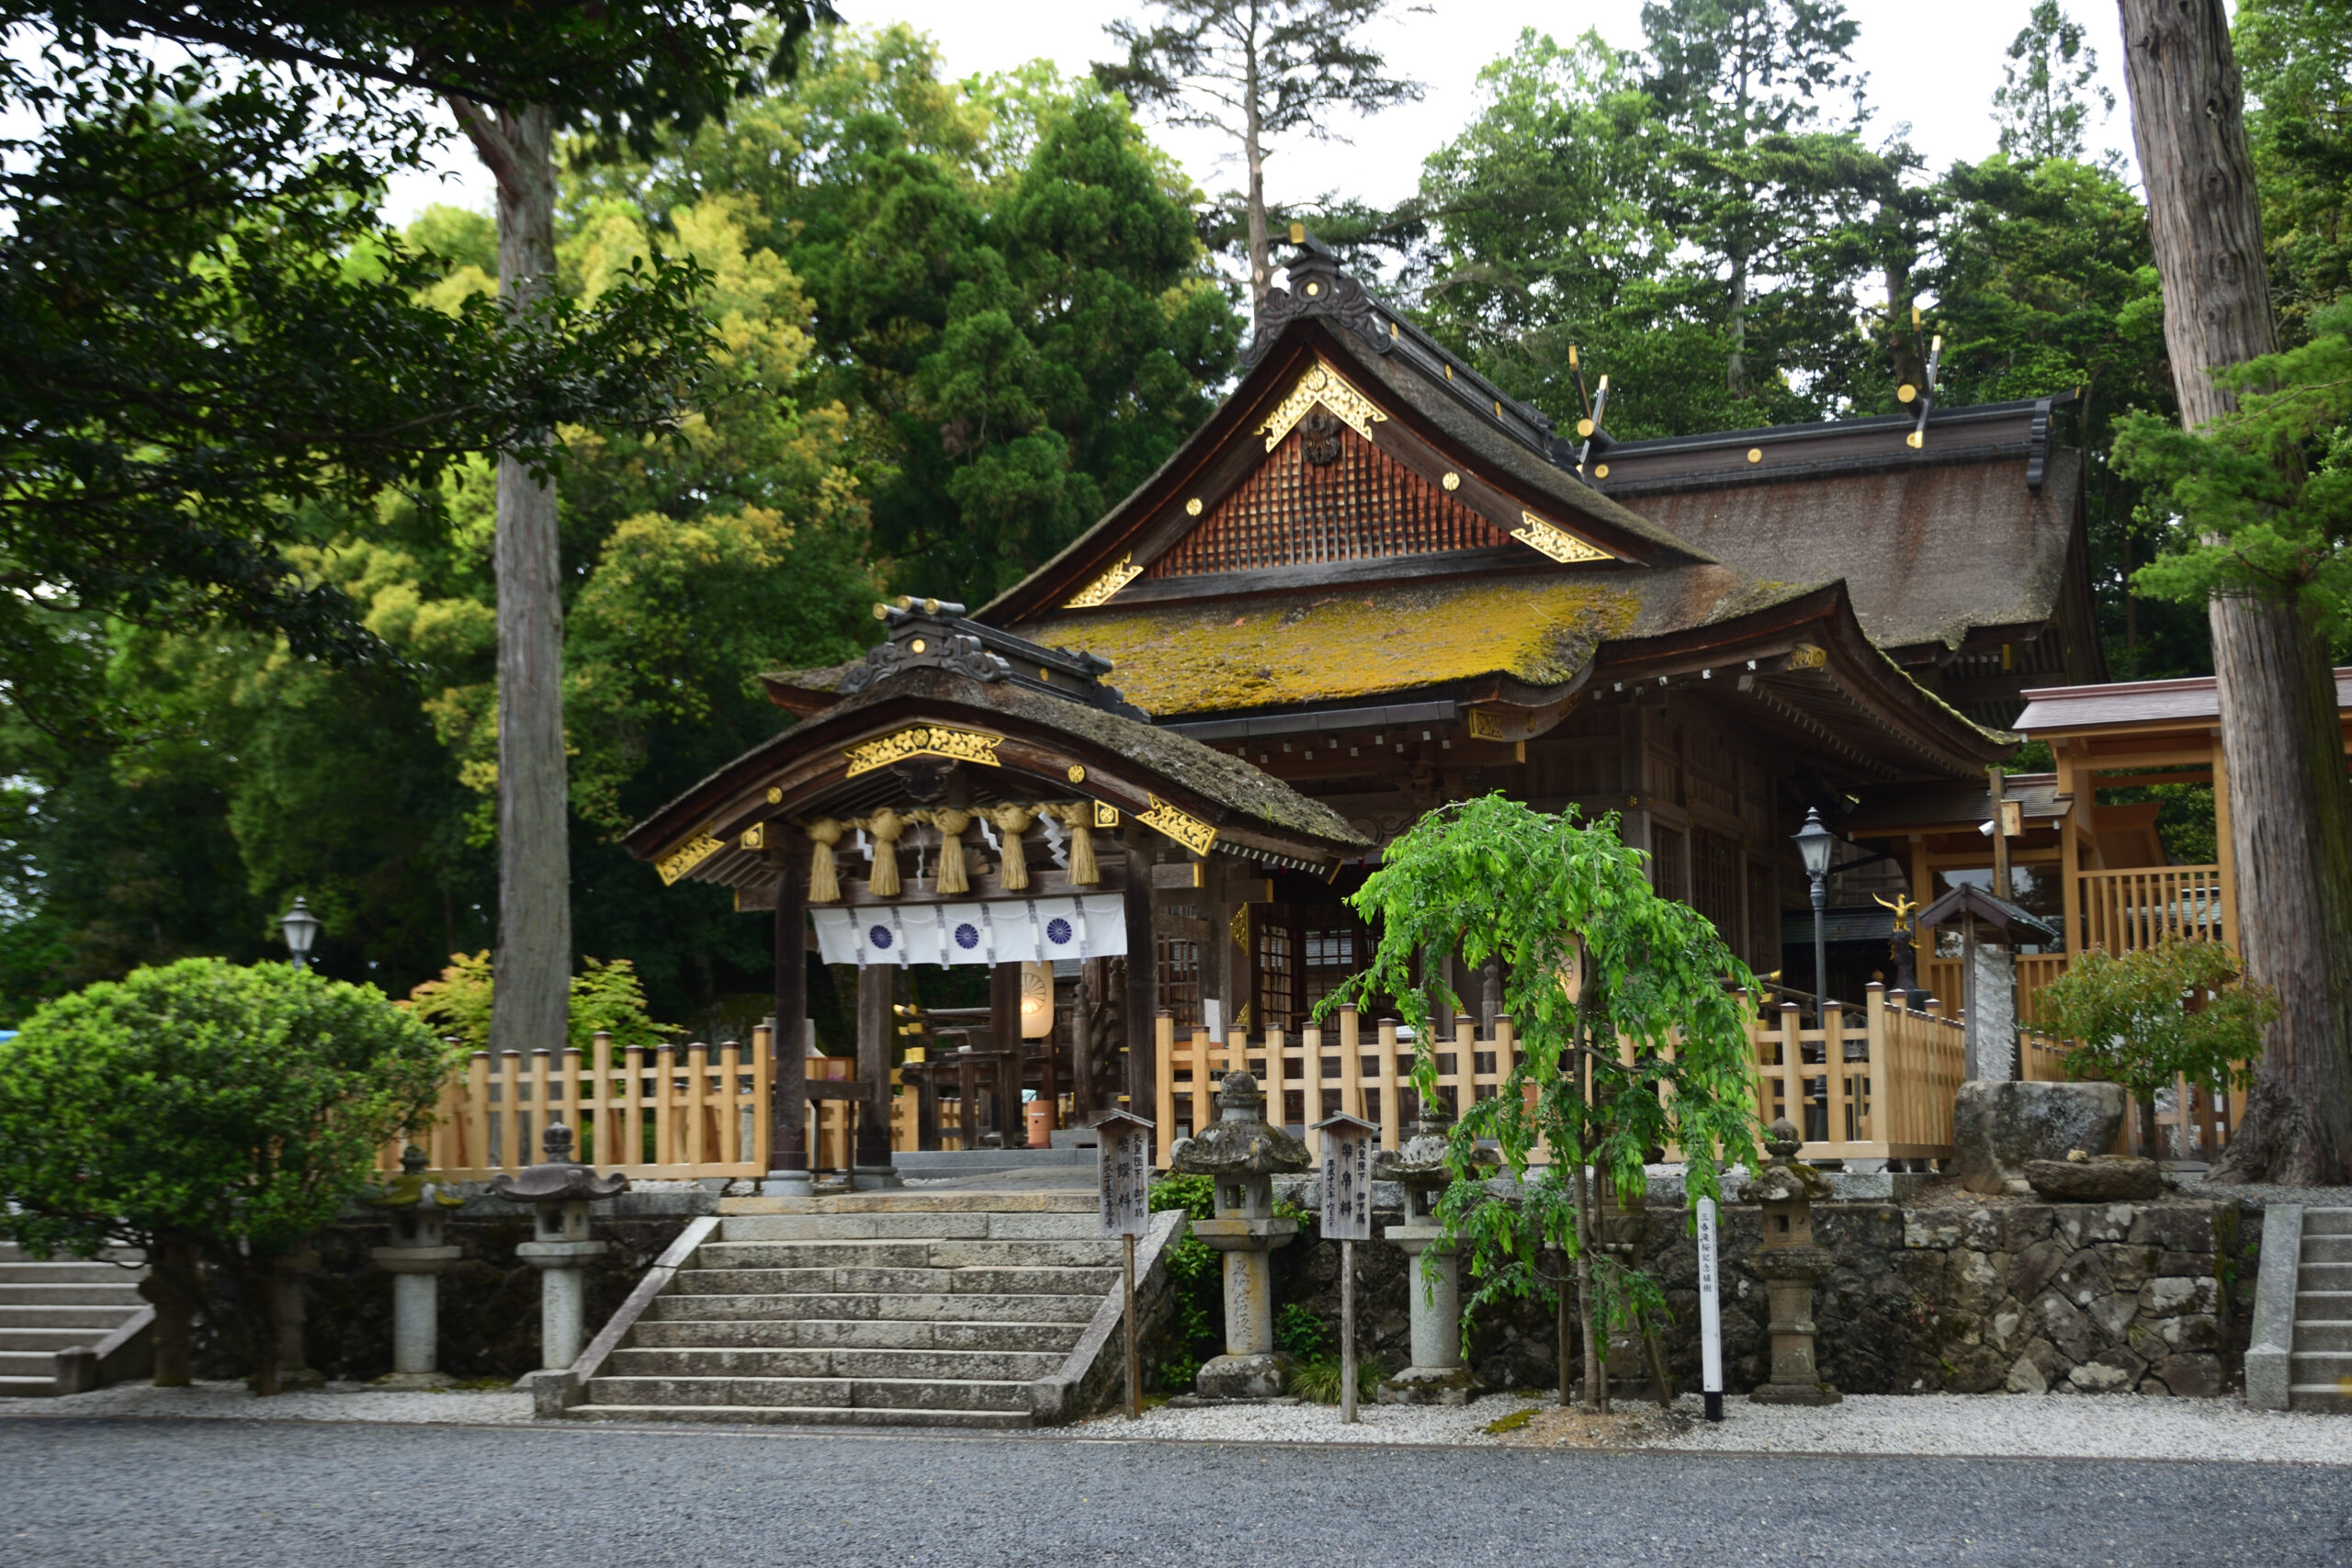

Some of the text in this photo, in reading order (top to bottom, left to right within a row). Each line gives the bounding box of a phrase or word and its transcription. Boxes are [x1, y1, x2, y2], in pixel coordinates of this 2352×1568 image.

[1133, 1134, 1143, 1179] 天皇陛下
[1339, 1143, 1352, 1220] 幣帛料
[1357, 1138, 1367, 1182] 天皇陛下
[1700, 1213, 1712, 1292] 三春滝桜記念植樹
